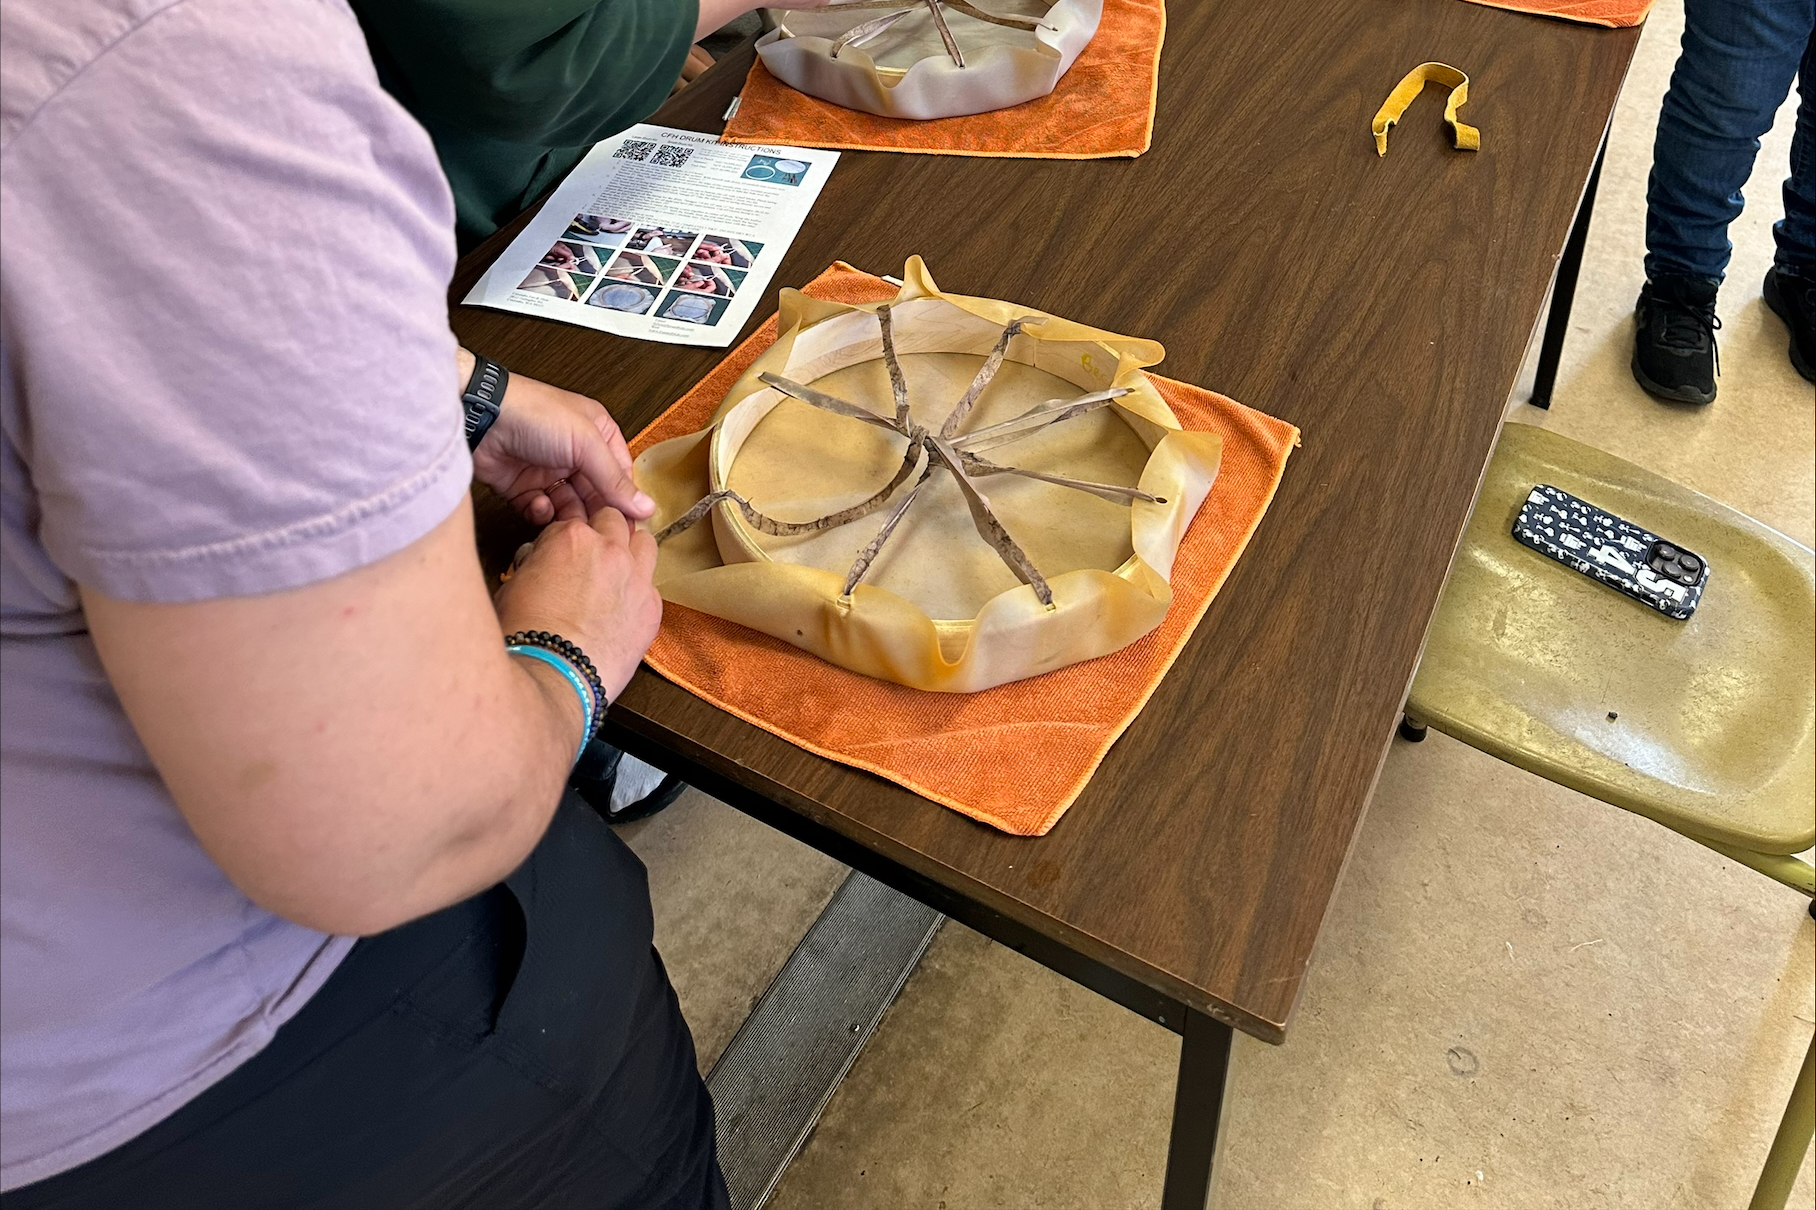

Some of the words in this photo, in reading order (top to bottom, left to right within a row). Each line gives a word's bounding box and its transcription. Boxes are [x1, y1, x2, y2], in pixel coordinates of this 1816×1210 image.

[661, 132, 677, 140] CFH
[677, 134, 705, 144] DRUM
[719, 140, 782, 155] INSTRUCTIONS
